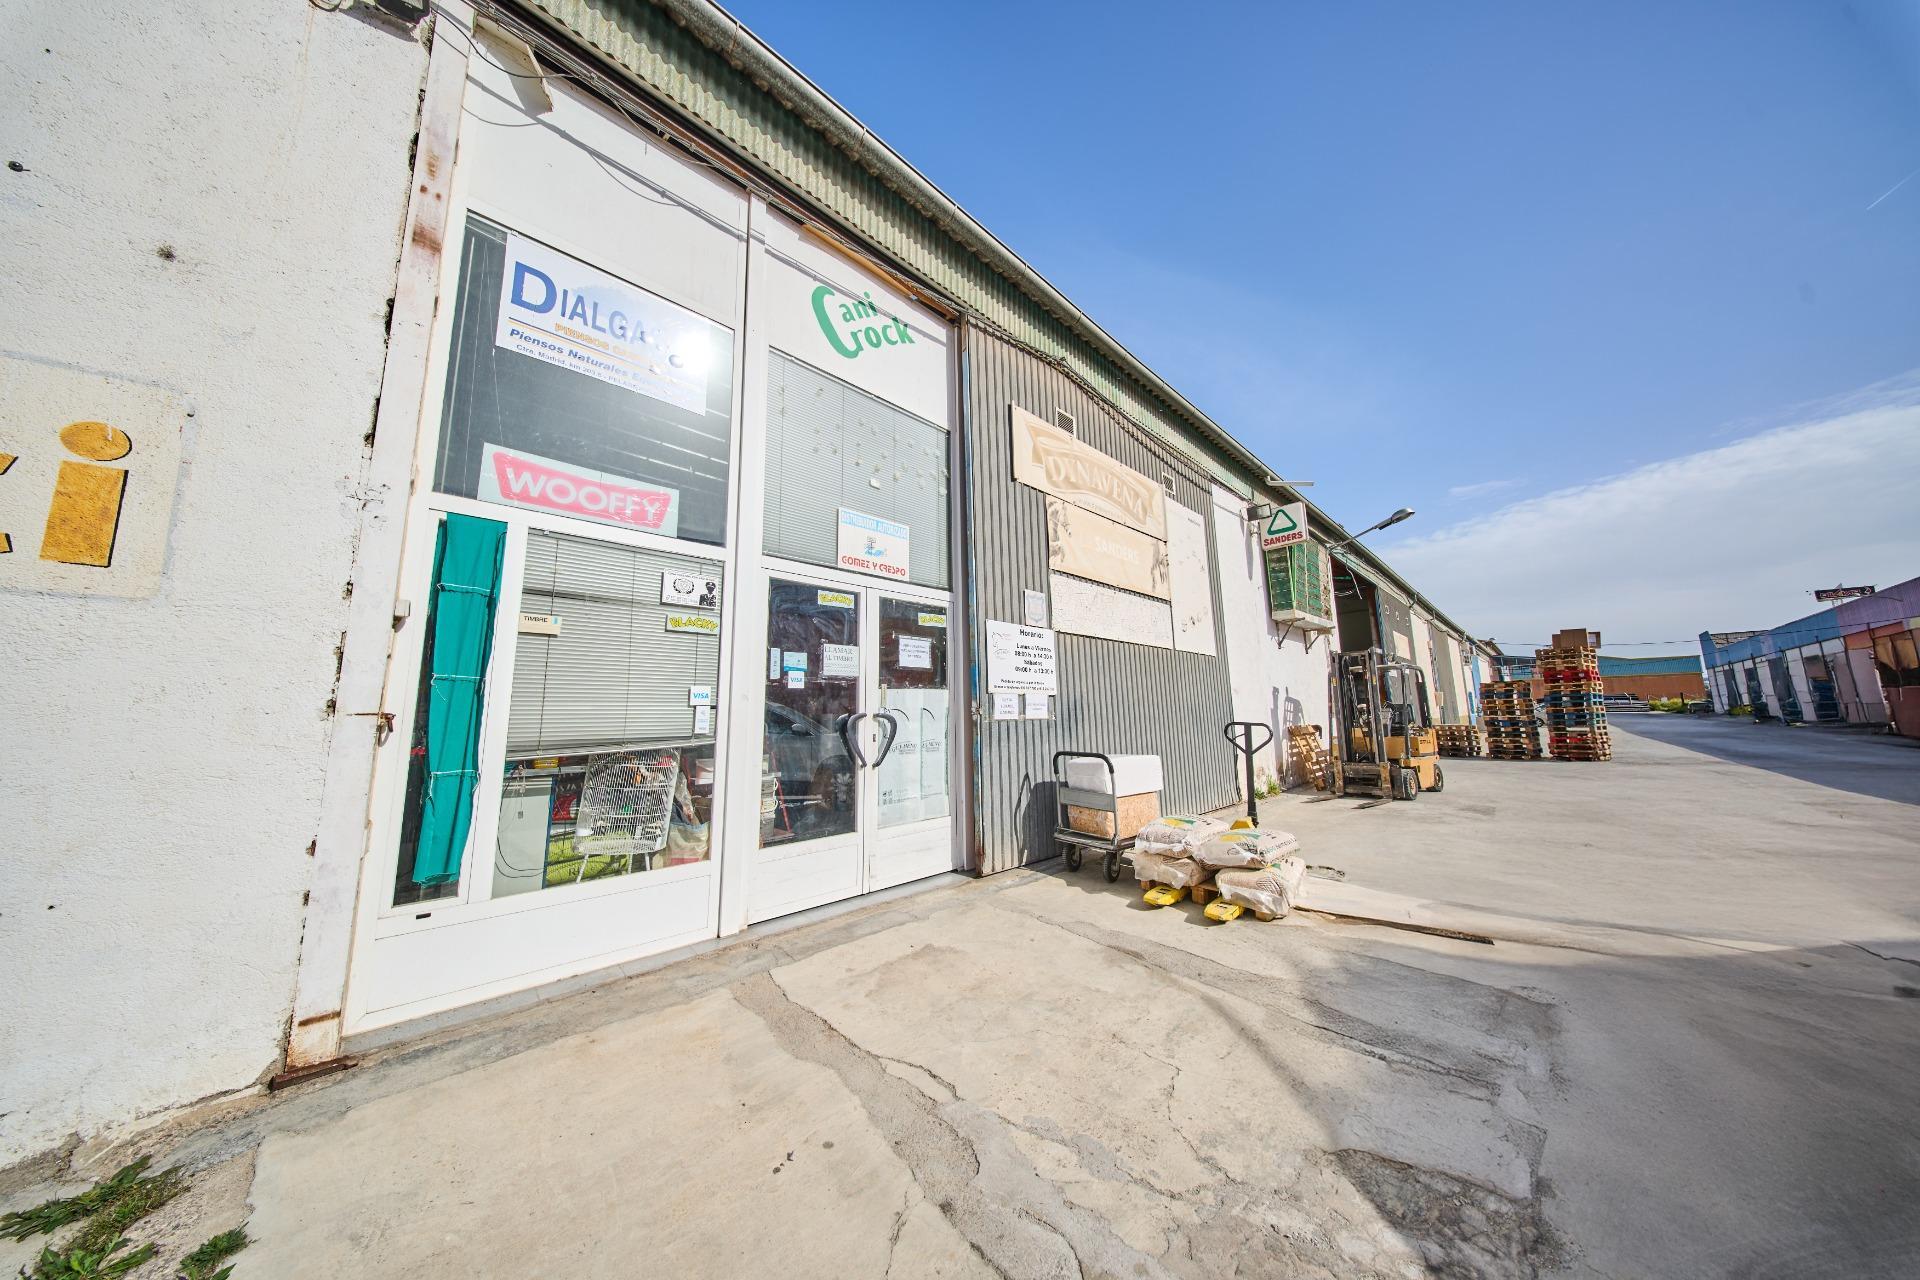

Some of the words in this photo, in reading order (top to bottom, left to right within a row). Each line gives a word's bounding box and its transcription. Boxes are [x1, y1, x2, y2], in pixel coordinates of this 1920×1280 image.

[509, 327, 564, 355] Piensos
[567, 348, 629, 378] Naturales
[504, 463, 661, 522] WOOFFY
[1046, 455, 1147, 517] DYNAVENA
[1263, 531, 1304, 547] SANDERS
[841, 555, 871, 570] GOMEZ
[872, 561, 878, 571] Y
[879, 563, 907, 577] CRESPO
[523, 615, 549, 623] TIMBRE
[669, 616, 719, 632] BLACKY
[1020, 628, 1044, 639] Horario:
[693, 692, 710, 700] VISA
